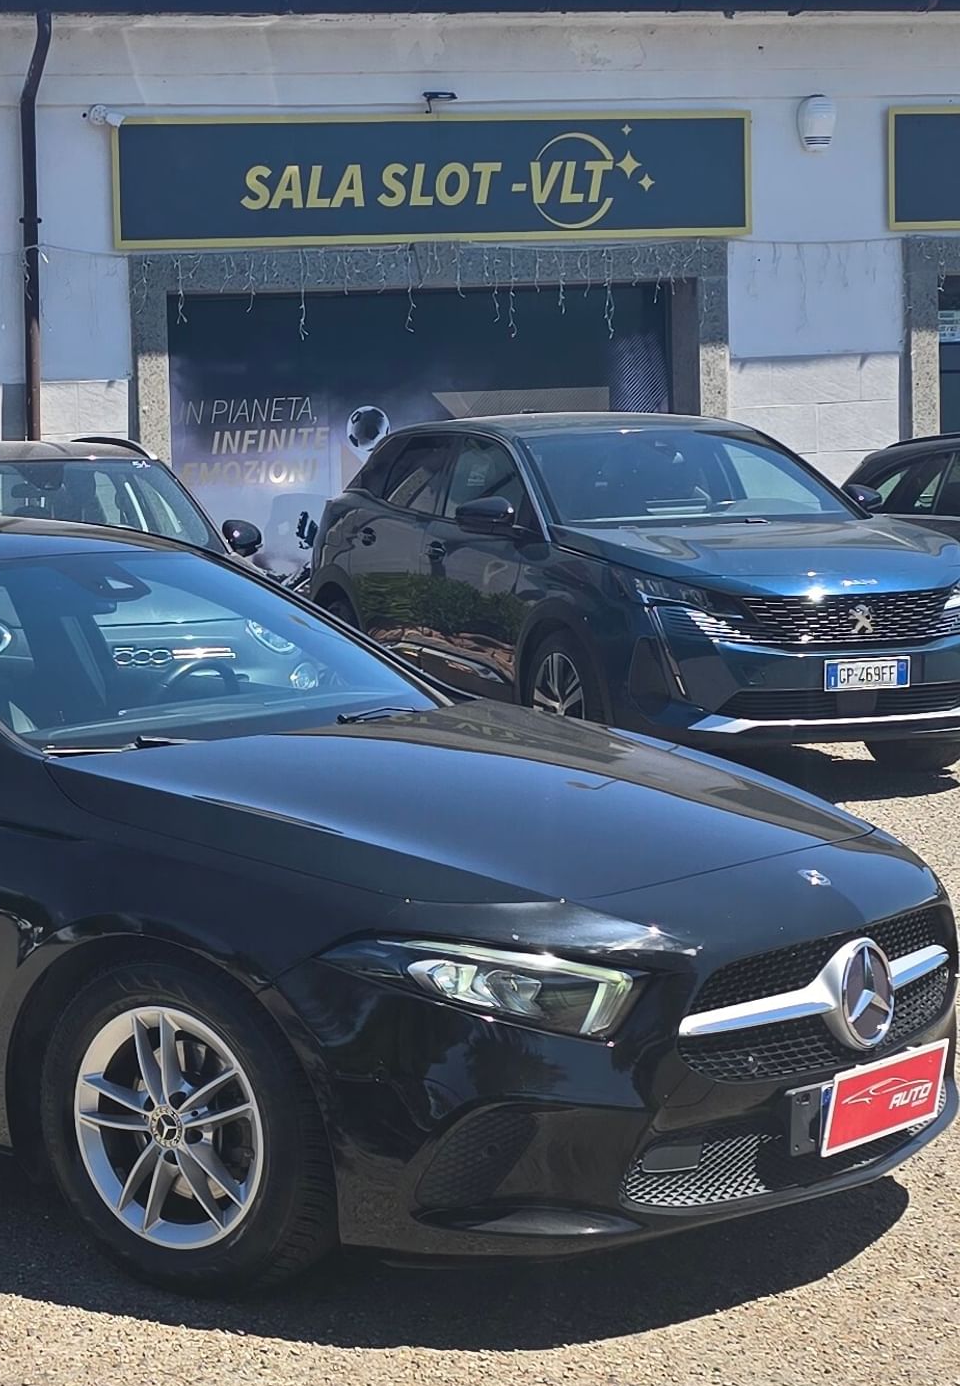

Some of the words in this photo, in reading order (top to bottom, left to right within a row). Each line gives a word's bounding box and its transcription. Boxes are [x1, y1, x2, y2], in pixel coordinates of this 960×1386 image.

[240, 164, 365, 210] SALA
[377, 162, 503, 207] SLOT
[211, 397, 318, 424] PIANETA,
[211, 426, 330, 455] INFINITE
[181, 458, 318, 487] EMOZIONI
[888, 1081, 933, 1110] AUTO
